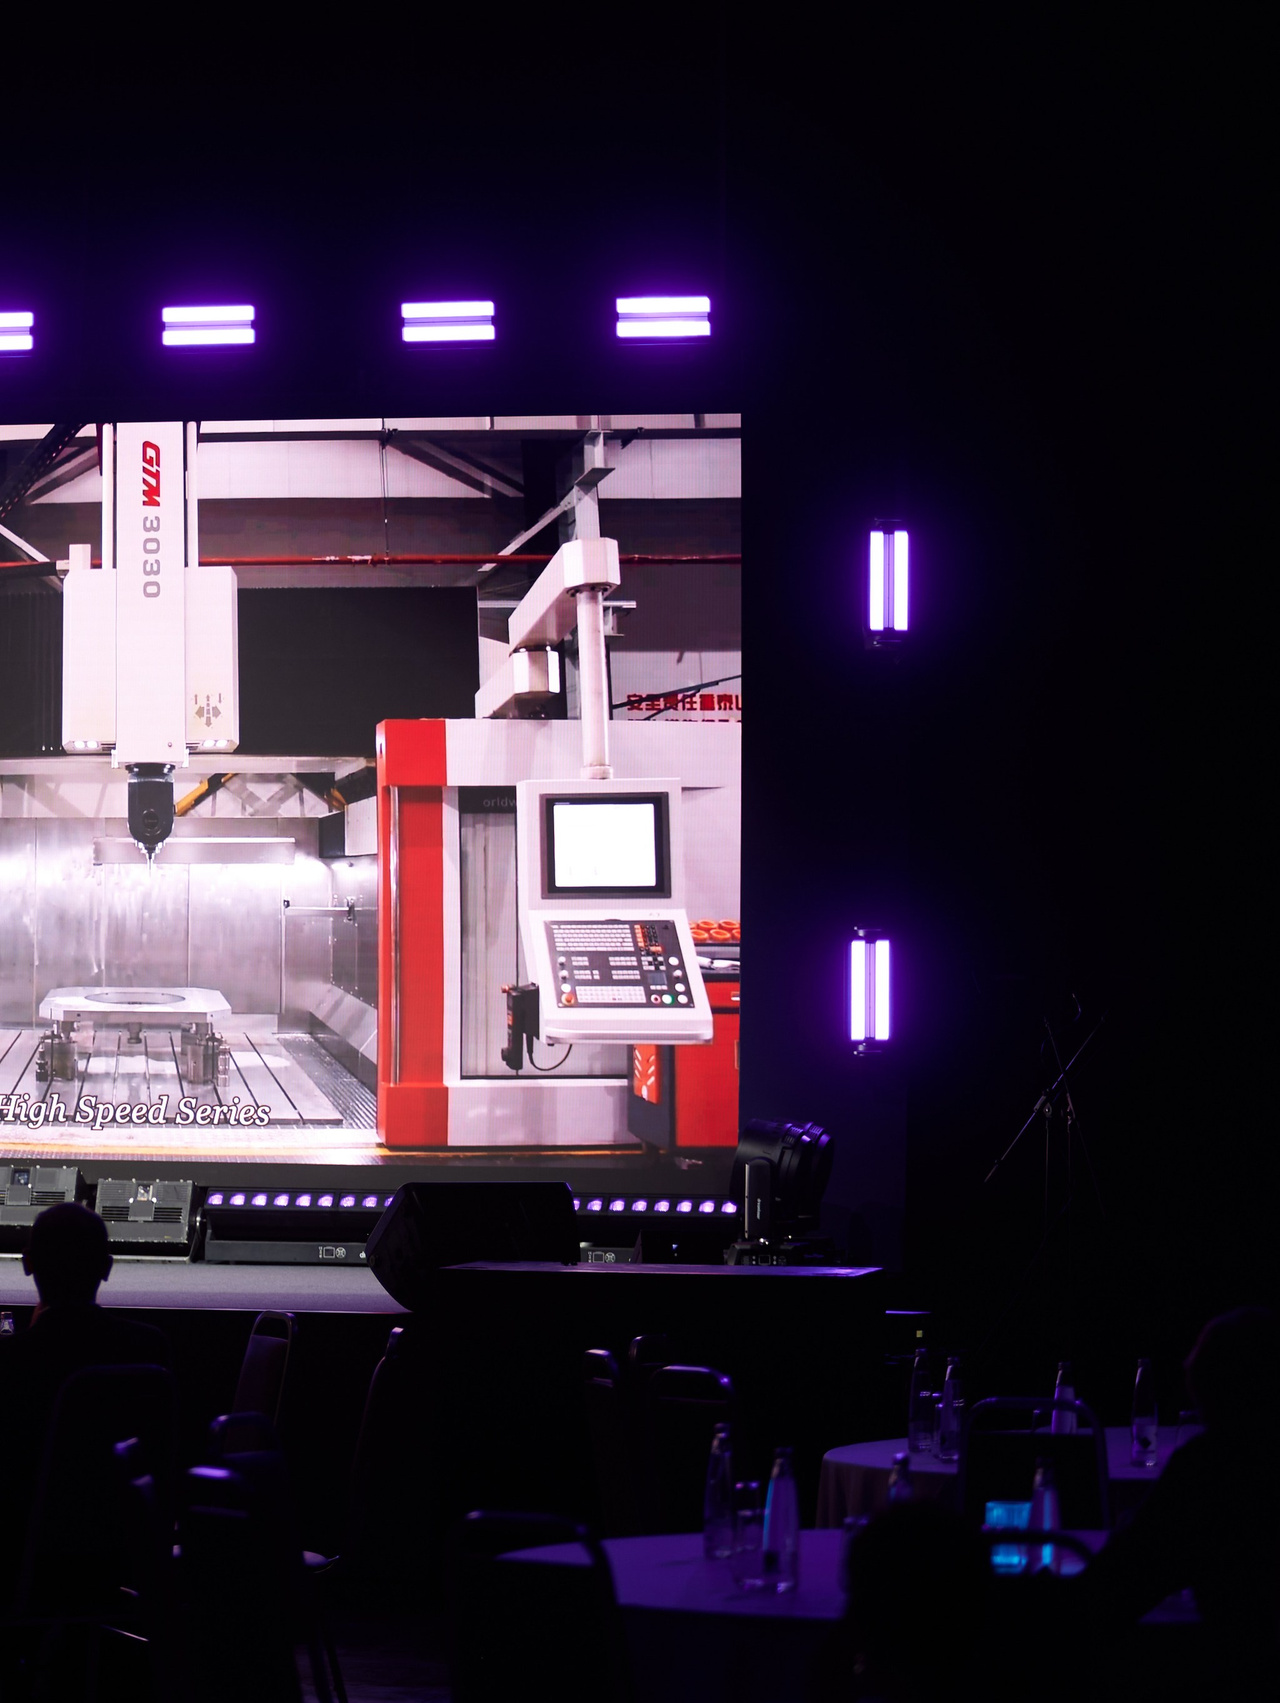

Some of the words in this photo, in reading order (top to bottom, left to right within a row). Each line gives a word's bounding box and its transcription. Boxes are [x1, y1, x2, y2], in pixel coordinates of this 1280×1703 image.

[142, 440, 161, 507] GTM
[142, 516, 161, 598] 3030
[75, 1094, 169, 1130] Speed
[175, 1096, 271, 1126] Series
